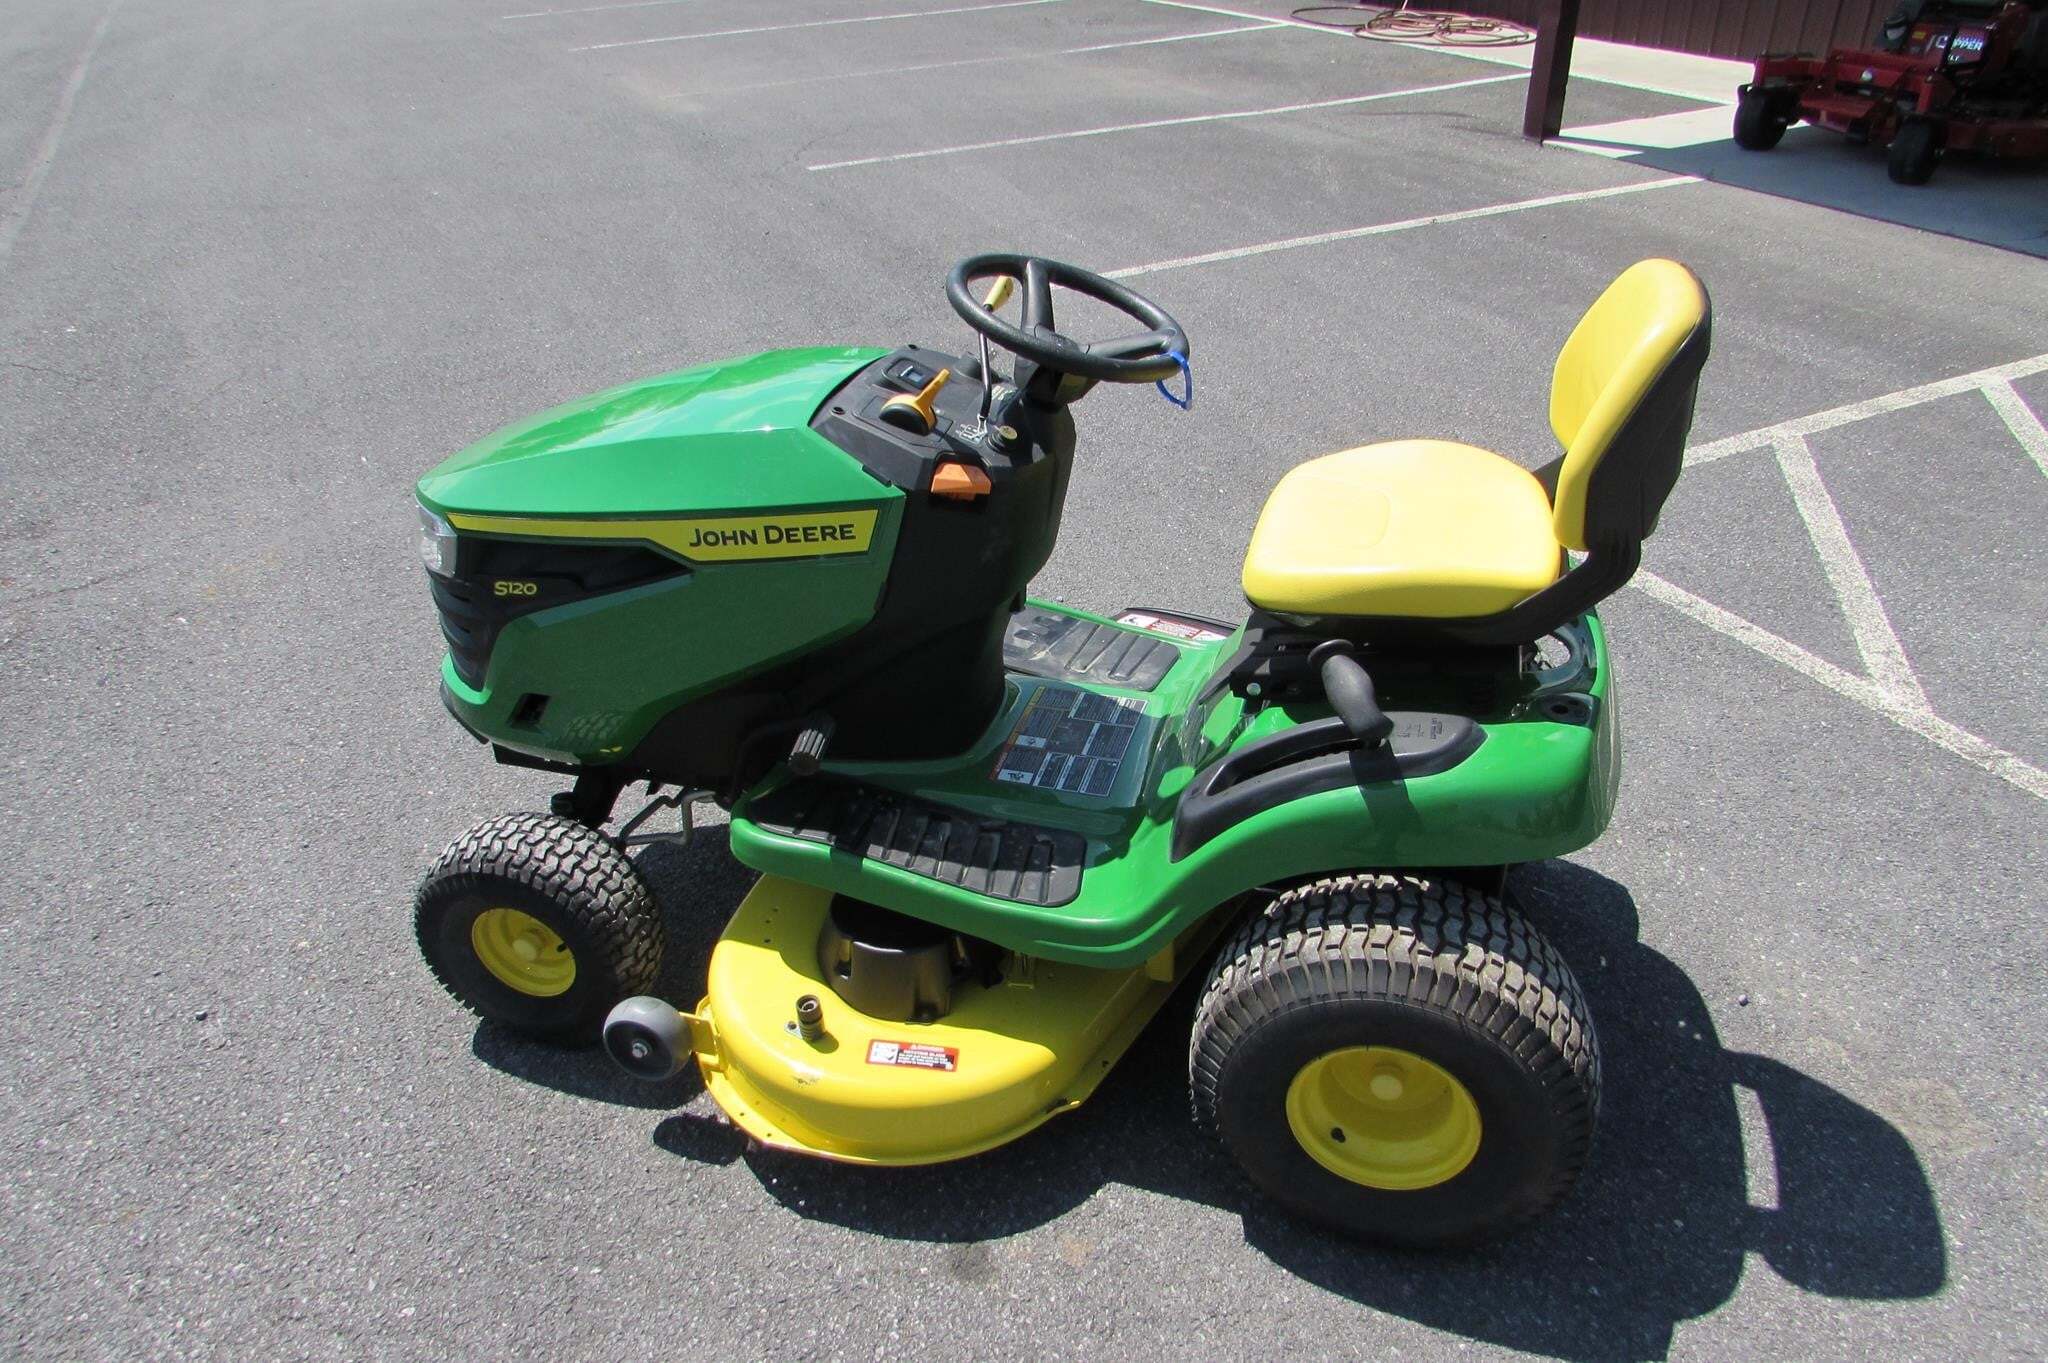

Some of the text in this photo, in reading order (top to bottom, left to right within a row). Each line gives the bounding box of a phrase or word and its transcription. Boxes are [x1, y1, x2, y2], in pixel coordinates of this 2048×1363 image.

[689, 523, 857, 547] JOHN DEERE
[495, 581, 538, 596] S120
